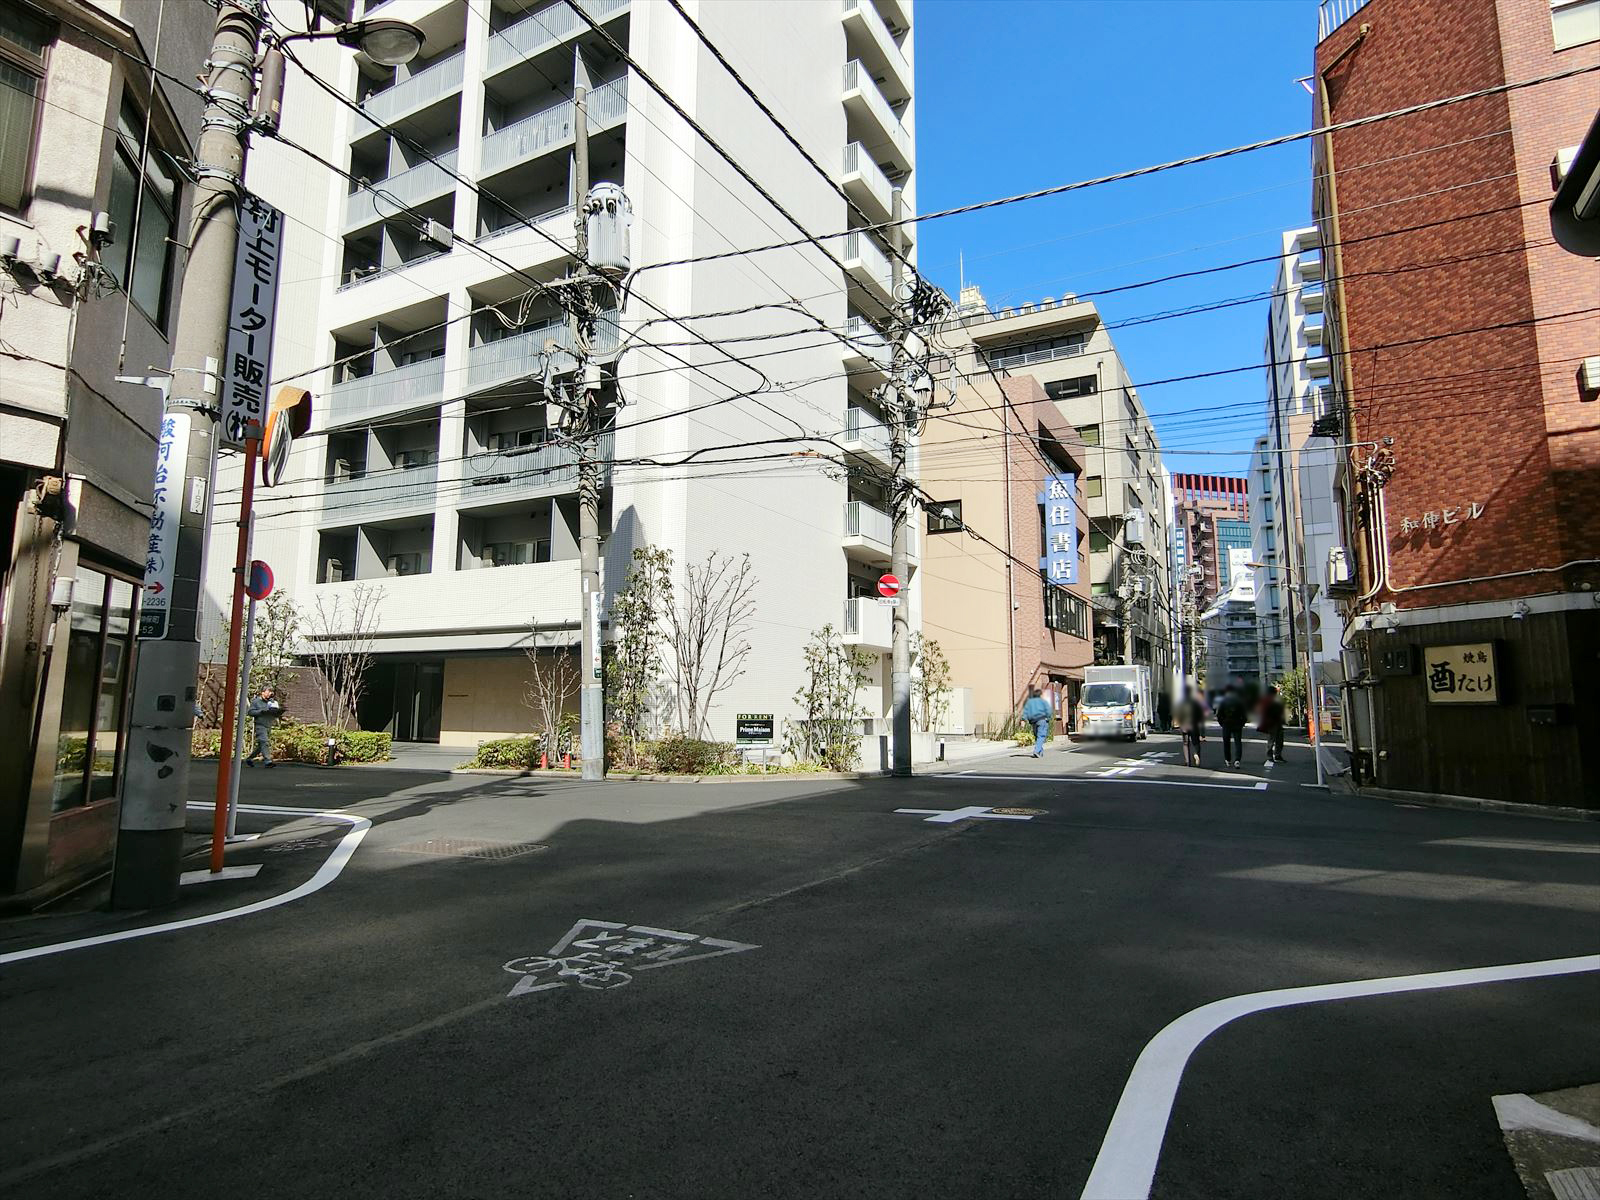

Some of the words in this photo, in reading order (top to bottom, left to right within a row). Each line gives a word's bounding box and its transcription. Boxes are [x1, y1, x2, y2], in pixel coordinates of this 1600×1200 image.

[226, 194, 279, 441] 村上モーター販売(株
[1048, 479, 1072, 580] 魚住書店
[1429, 661, 1492, 694] 酉たけ
[1463, 650, 1488, 664] 焼鳥
